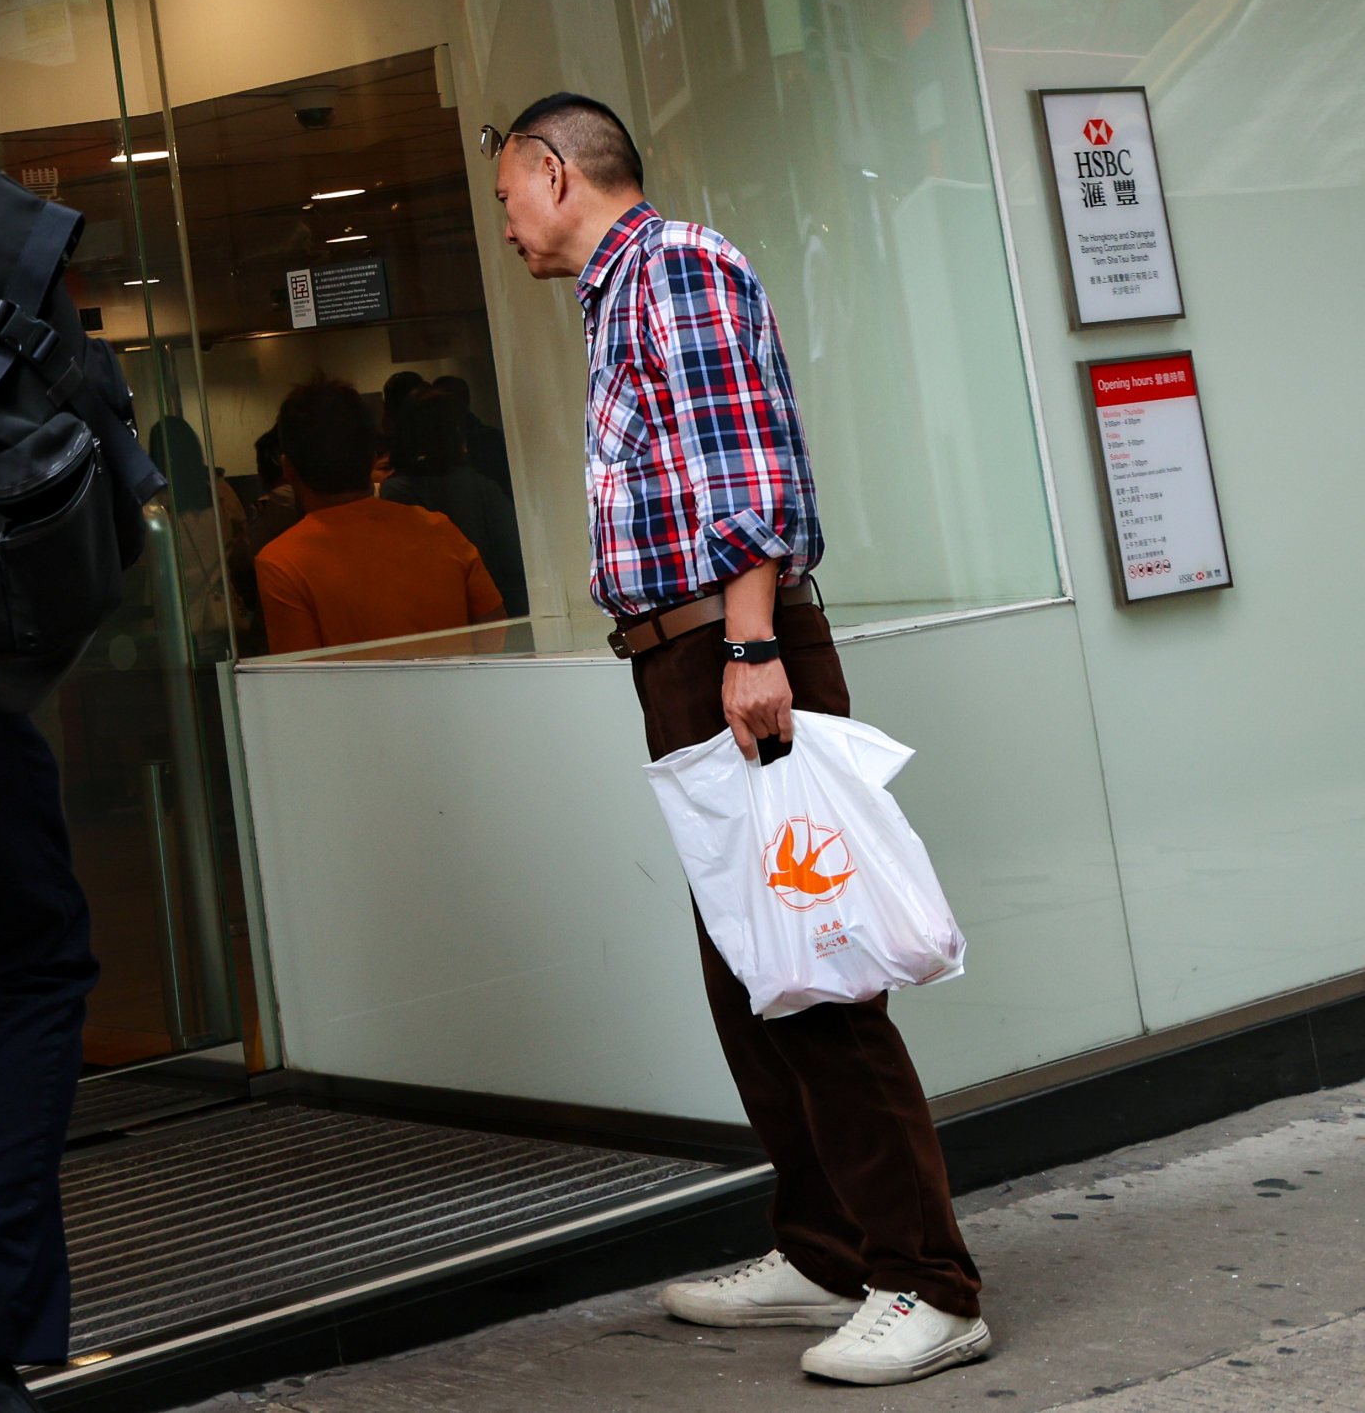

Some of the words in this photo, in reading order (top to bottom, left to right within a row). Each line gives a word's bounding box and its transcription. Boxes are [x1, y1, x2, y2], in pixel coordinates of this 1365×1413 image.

[1074, 149, 1134, 179] HSBC
[1097, 377, 1130, 393] Opening
[1131, 375, 1154, 387] hours
